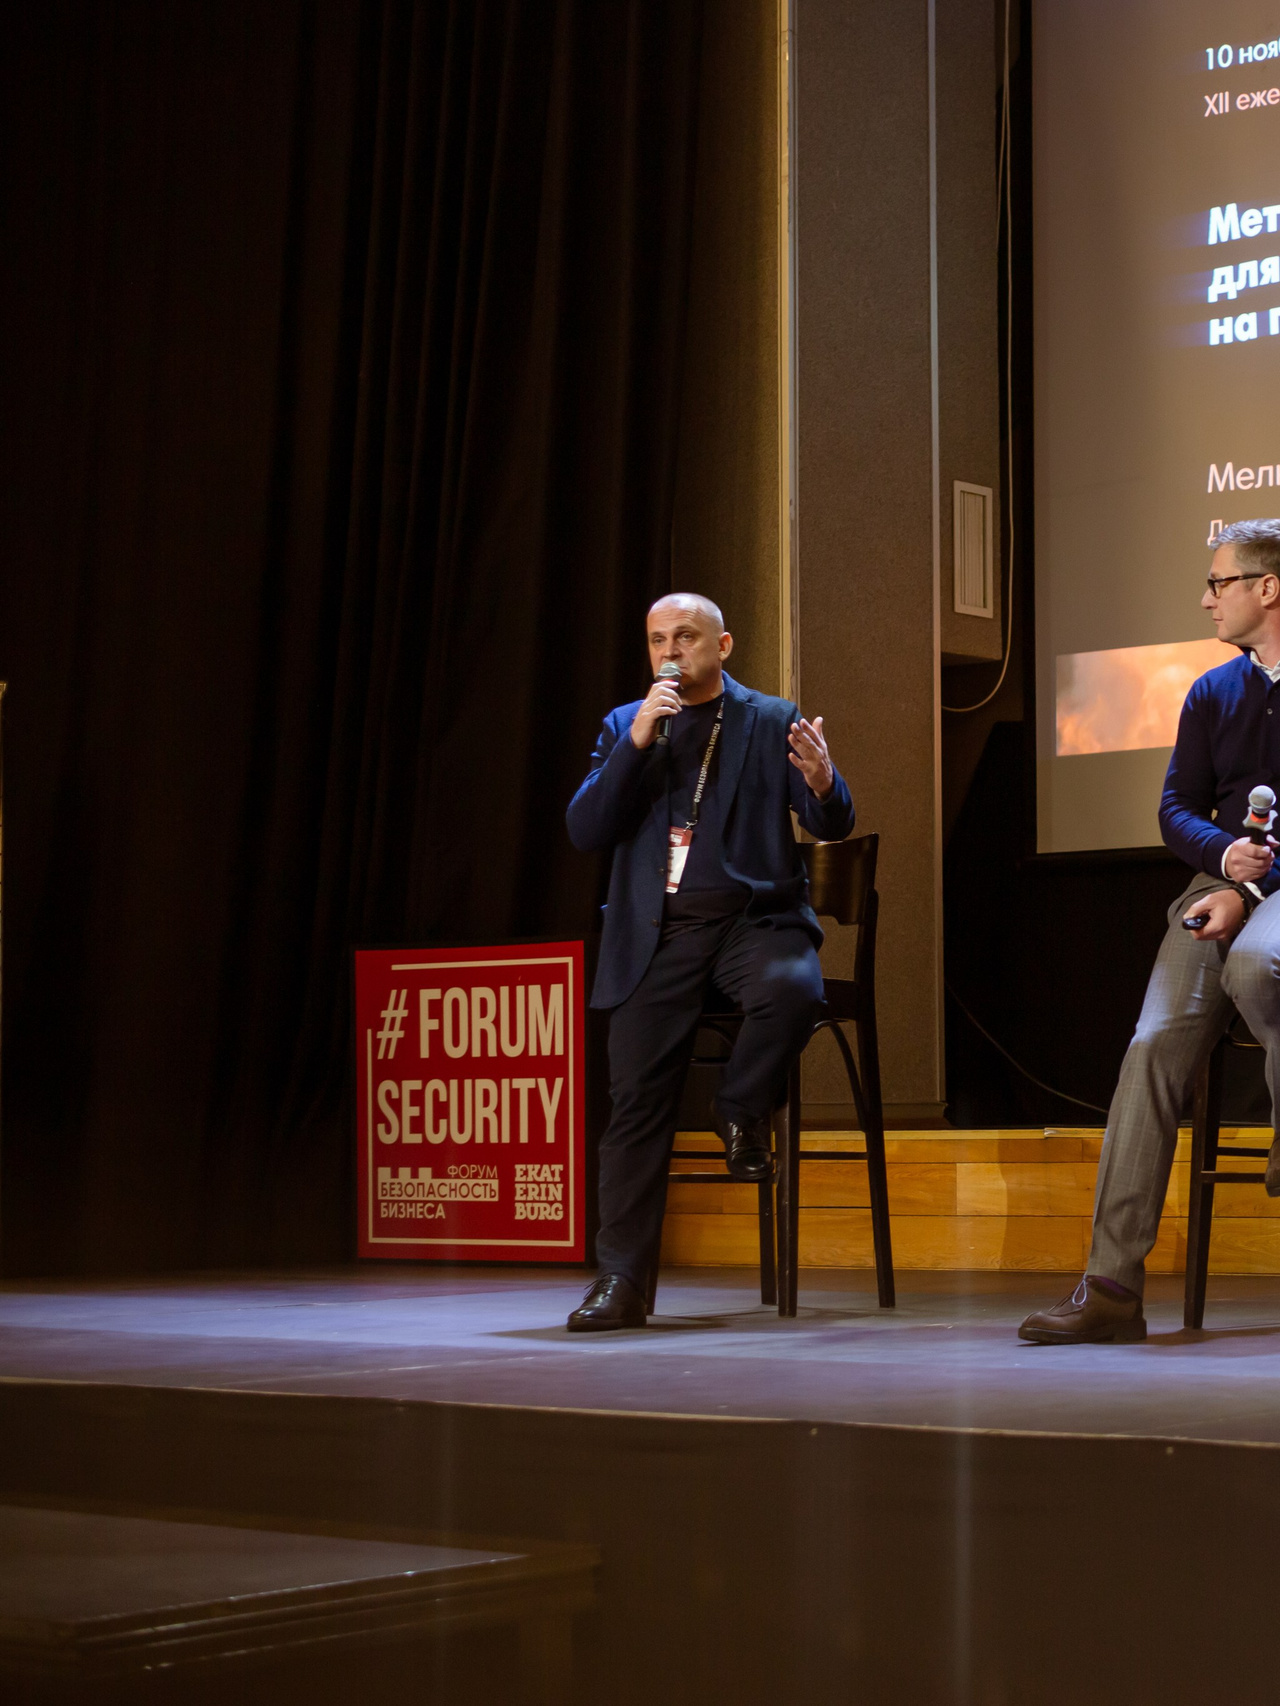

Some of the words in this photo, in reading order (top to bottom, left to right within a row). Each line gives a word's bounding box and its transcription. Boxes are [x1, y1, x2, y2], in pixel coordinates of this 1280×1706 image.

[1205, 44, 1233, 70] 10
[1204, 92, 1229, 117] XII
[1207, 253, 1280, 302] для
[1208, 311, 1258, 346] на
[419, 984, 564, 1058] FORUM
[377, 1077, 564, 1144] SECURITY
[447, 1164, 498, 1180] ФОРУМ
[514, 1164, 563, 1182] EKAT
[380, 1181, 497, 1199] БЕЗОПАСНОСТЬ
[514, 1183, 563, 1201] ERIN
[380, 1203, 446, 1219] БИЗНЕСА
[514, 1202, 564, 1220] BURG
